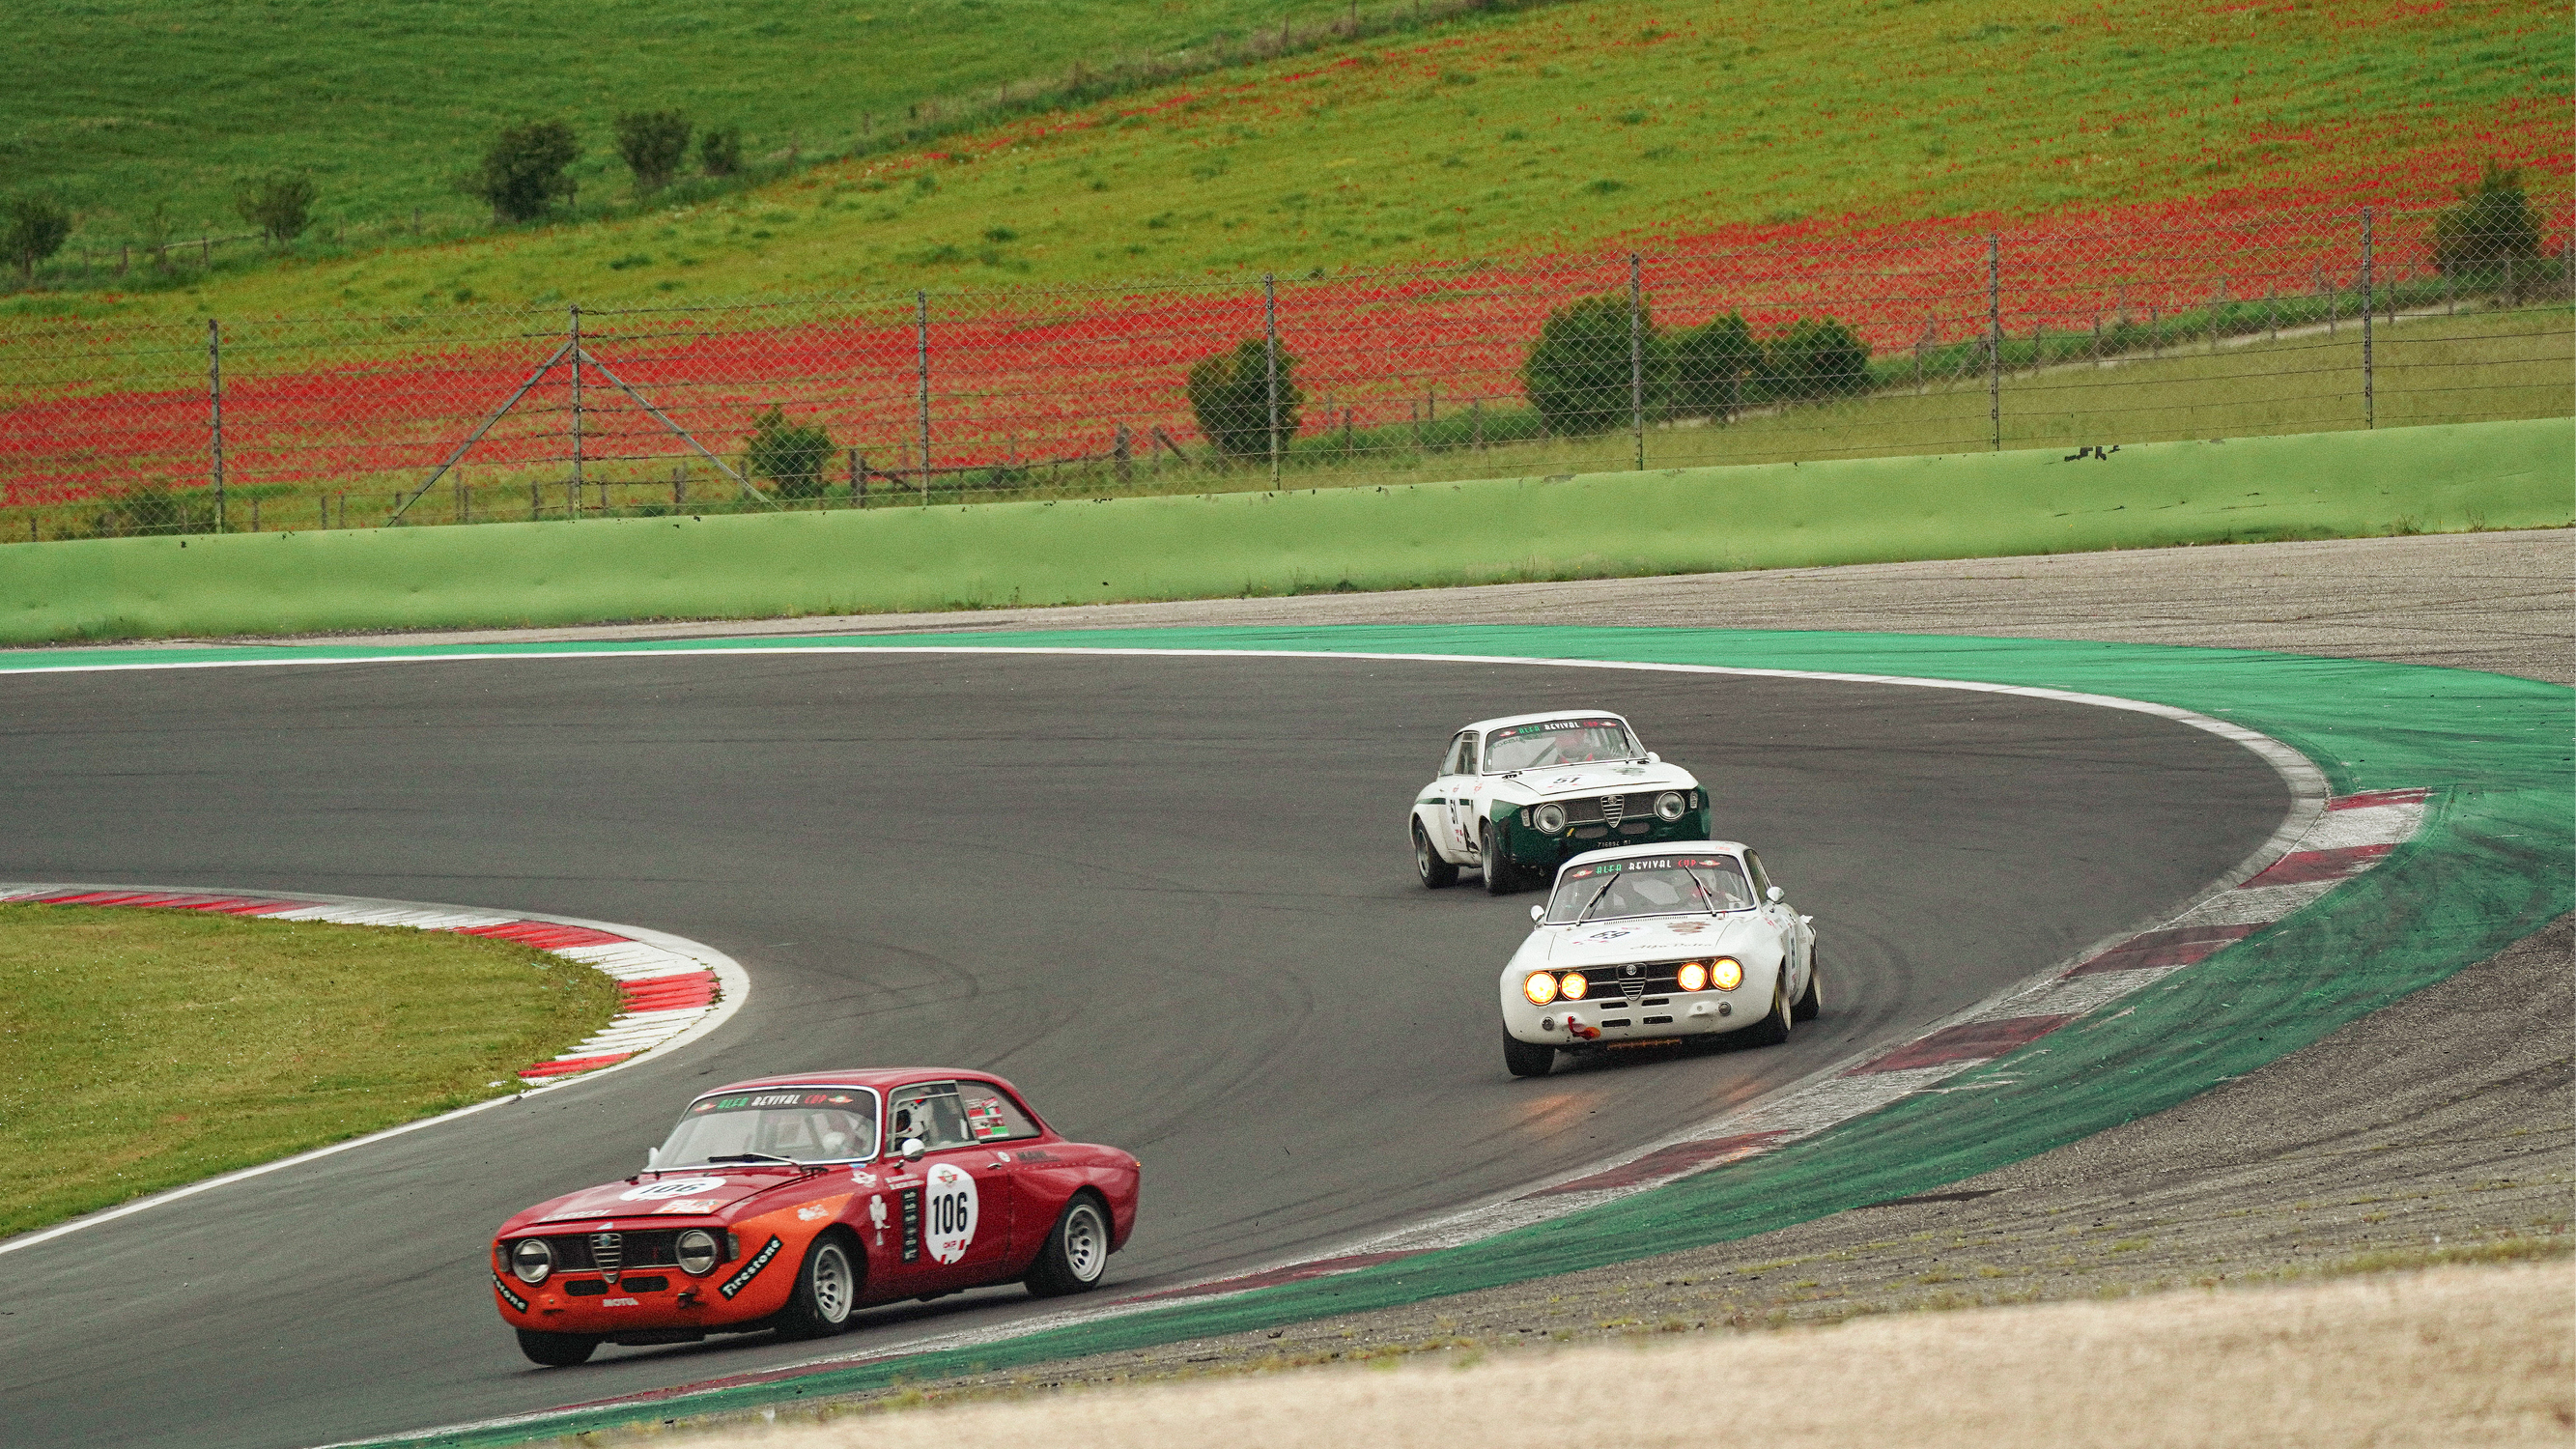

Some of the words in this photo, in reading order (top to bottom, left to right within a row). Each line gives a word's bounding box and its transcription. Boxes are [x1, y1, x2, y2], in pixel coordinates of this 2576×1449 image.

[1544, 722, 1580, 730] REVIVAL
[1596, 864, 1622, 874] ALFA
[1628, 859, 1672, 870] REVIVAL
[1678, 859, 1697, 867] CUP
[717, 1097, 750, 1109] ALFA
[751, 1094, 802, 1106] REVIVAL
[805, 1094, 828, 1104] CUP
[639, 1183, 706, 1195] 106
[933, 1191, 969, 1236] 106
[722, 1238, 780, 1296] Firestone
